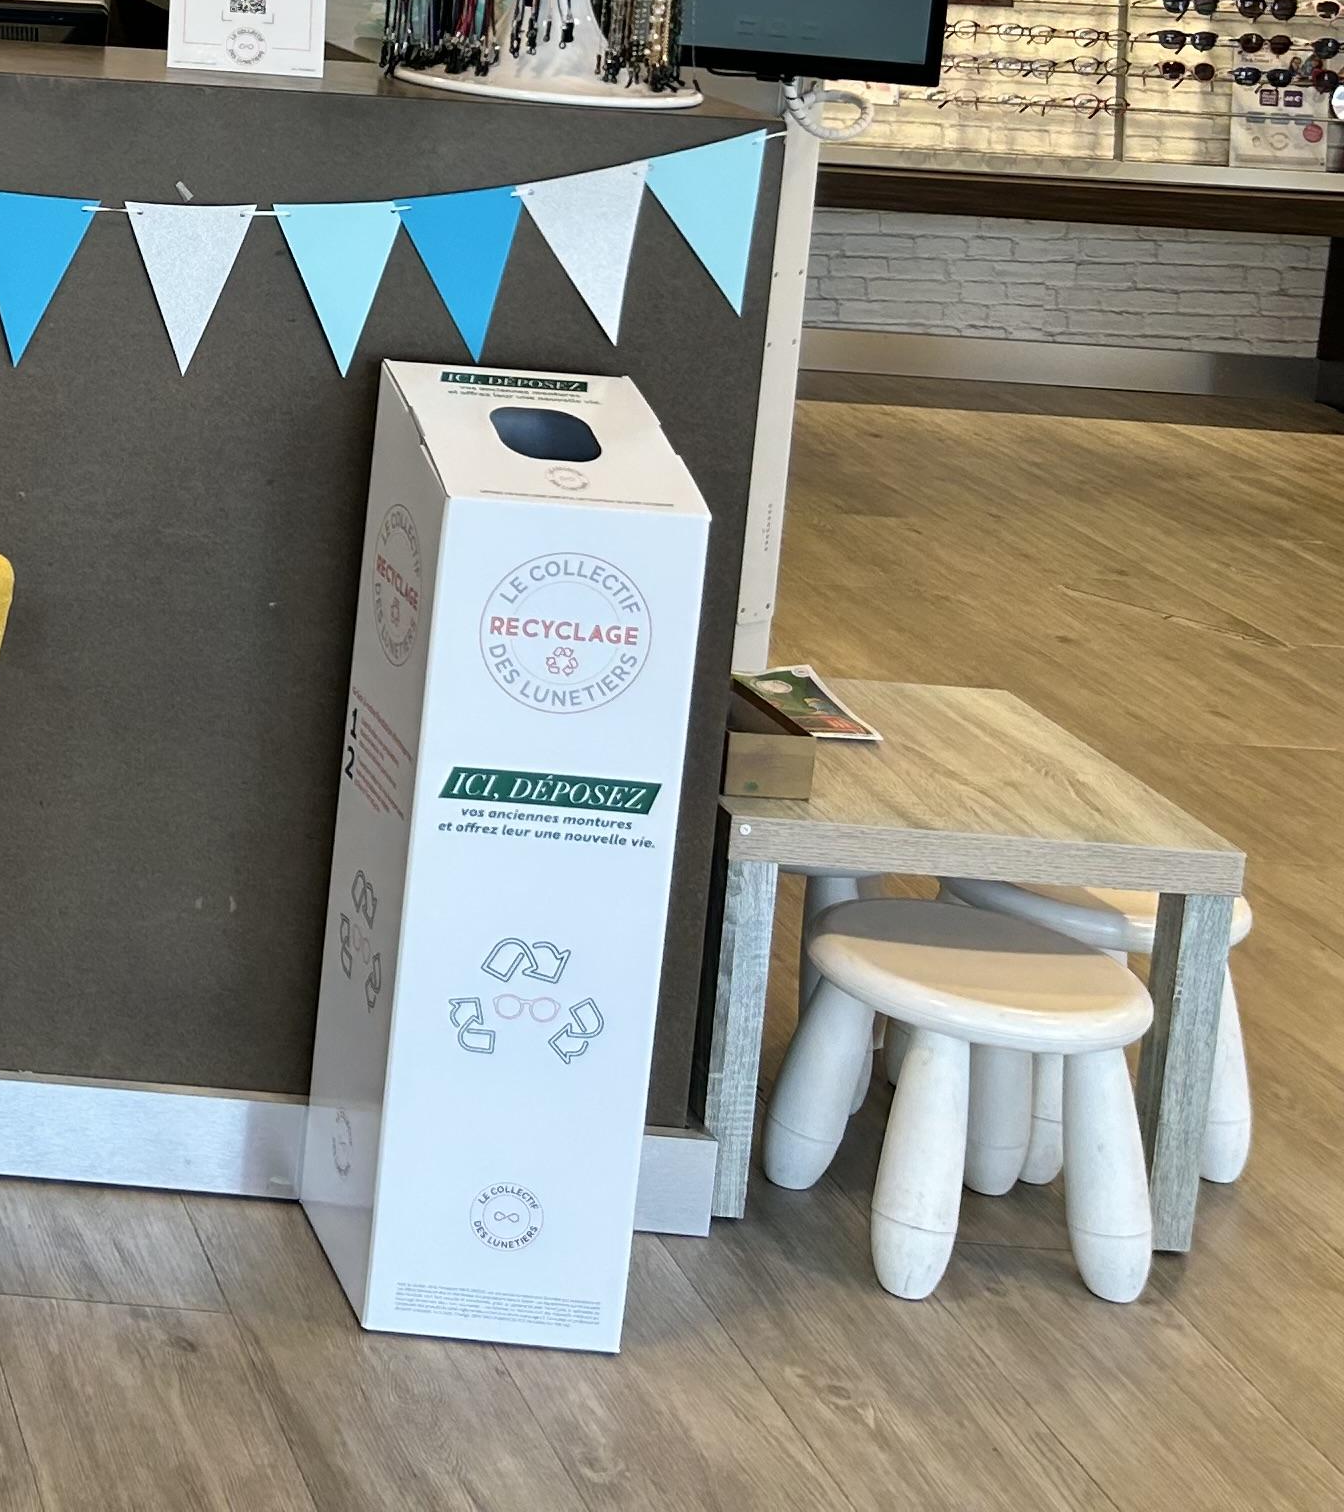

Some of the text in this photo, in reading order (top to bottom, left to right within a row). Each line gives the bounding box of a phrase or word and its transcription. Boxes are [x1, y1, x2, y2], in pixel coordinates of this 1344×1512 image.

[448, 373, 482, 385] ICI,
[499, 559, 641, 614] LE COLLECTIF
[490, 616, 639, 646] RECYCLAGE
[489, 643, 638, 707] DES LUNETIERS
[350, 707, 358, 740] 1
[344, 745, 355, 780] 2
[451, 772, 647, 810] ICI, DÉPOSEZ
[461, 808, 633, 830] vos anciennes montures
[438, 821, 656, 849] et offrez leur une nouvelle vie.
[478, 1185, 540, 1210] LE COLLECTIF
[474, 1220, 539, 1248] DES LUNETIERS
